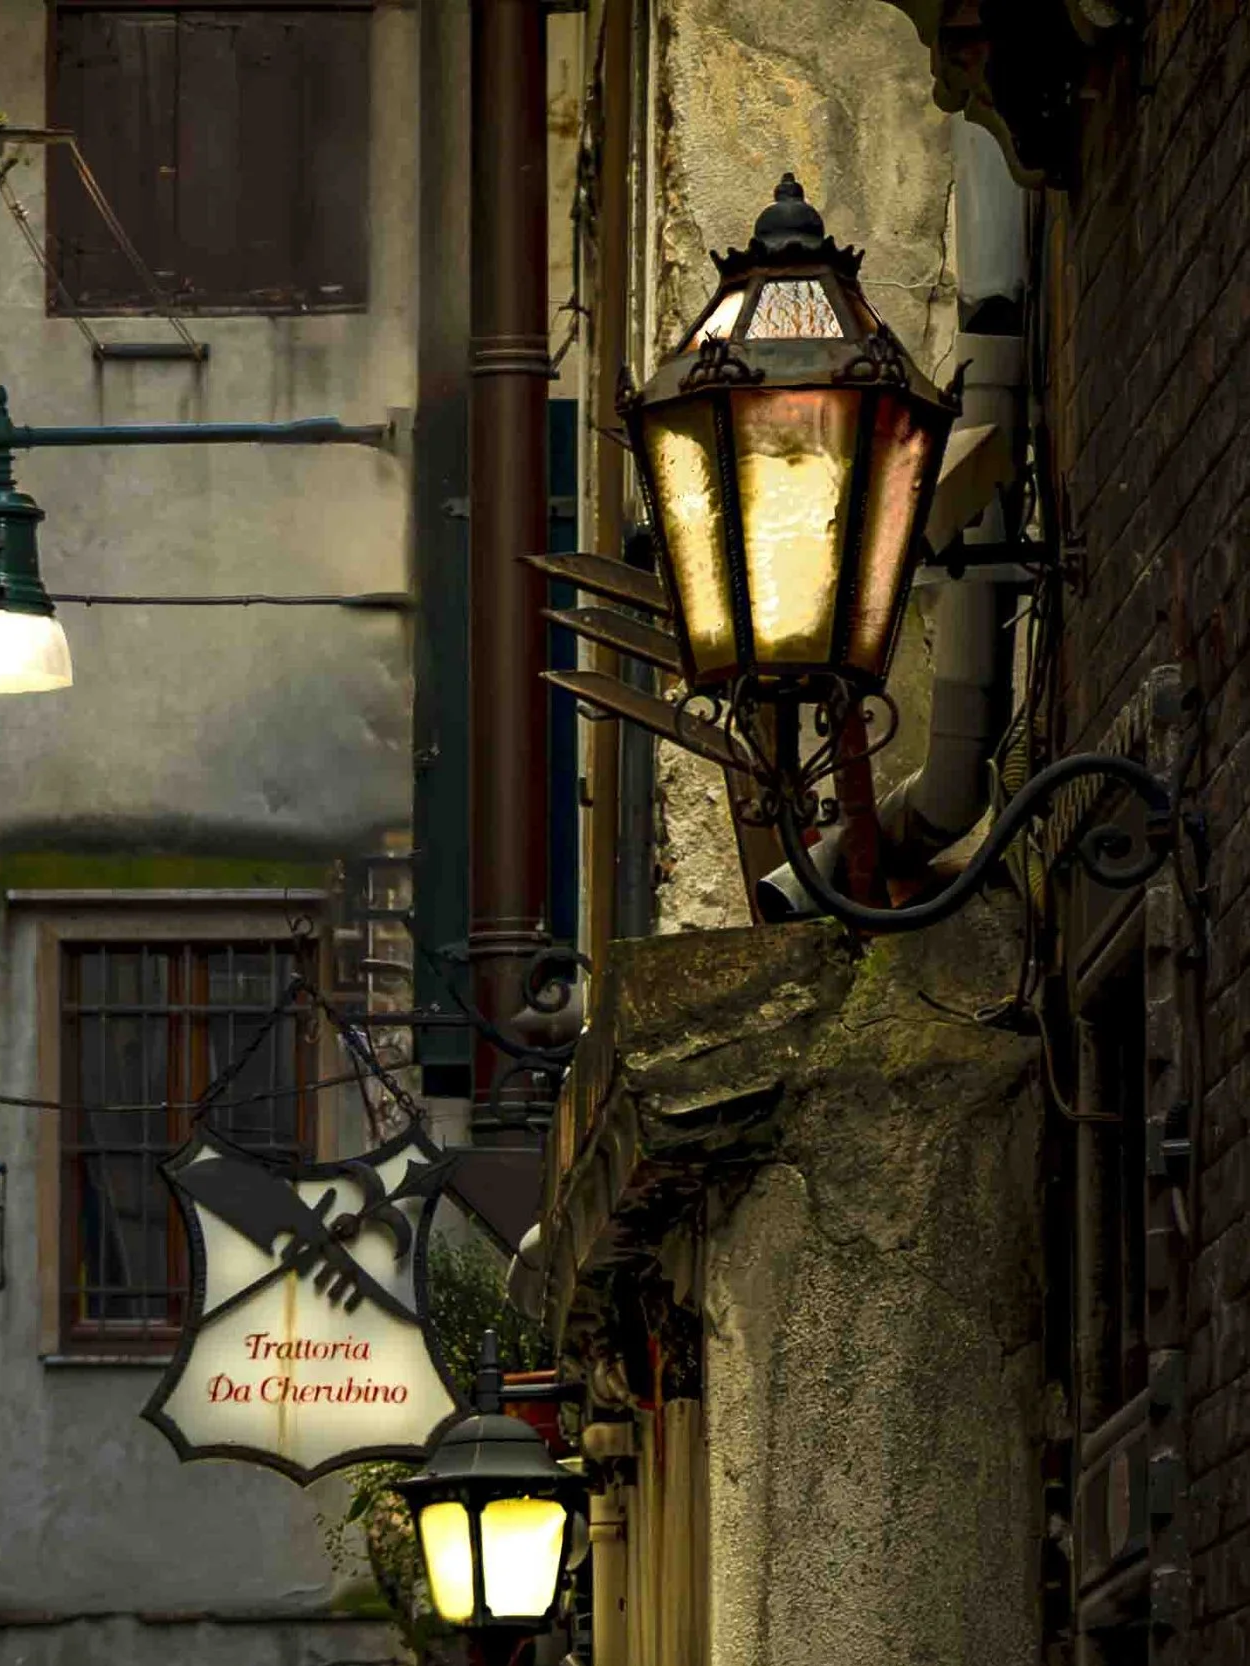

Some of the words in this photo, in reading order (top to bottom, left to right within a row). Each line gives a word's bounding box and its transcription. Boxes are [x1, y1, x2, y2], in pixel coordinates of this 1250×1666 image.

[245, 1332, 370, 1360] Trattoria
[207, 1372, 250, 1403] Da
[260, 1374, 408, 1404] Cherubino
